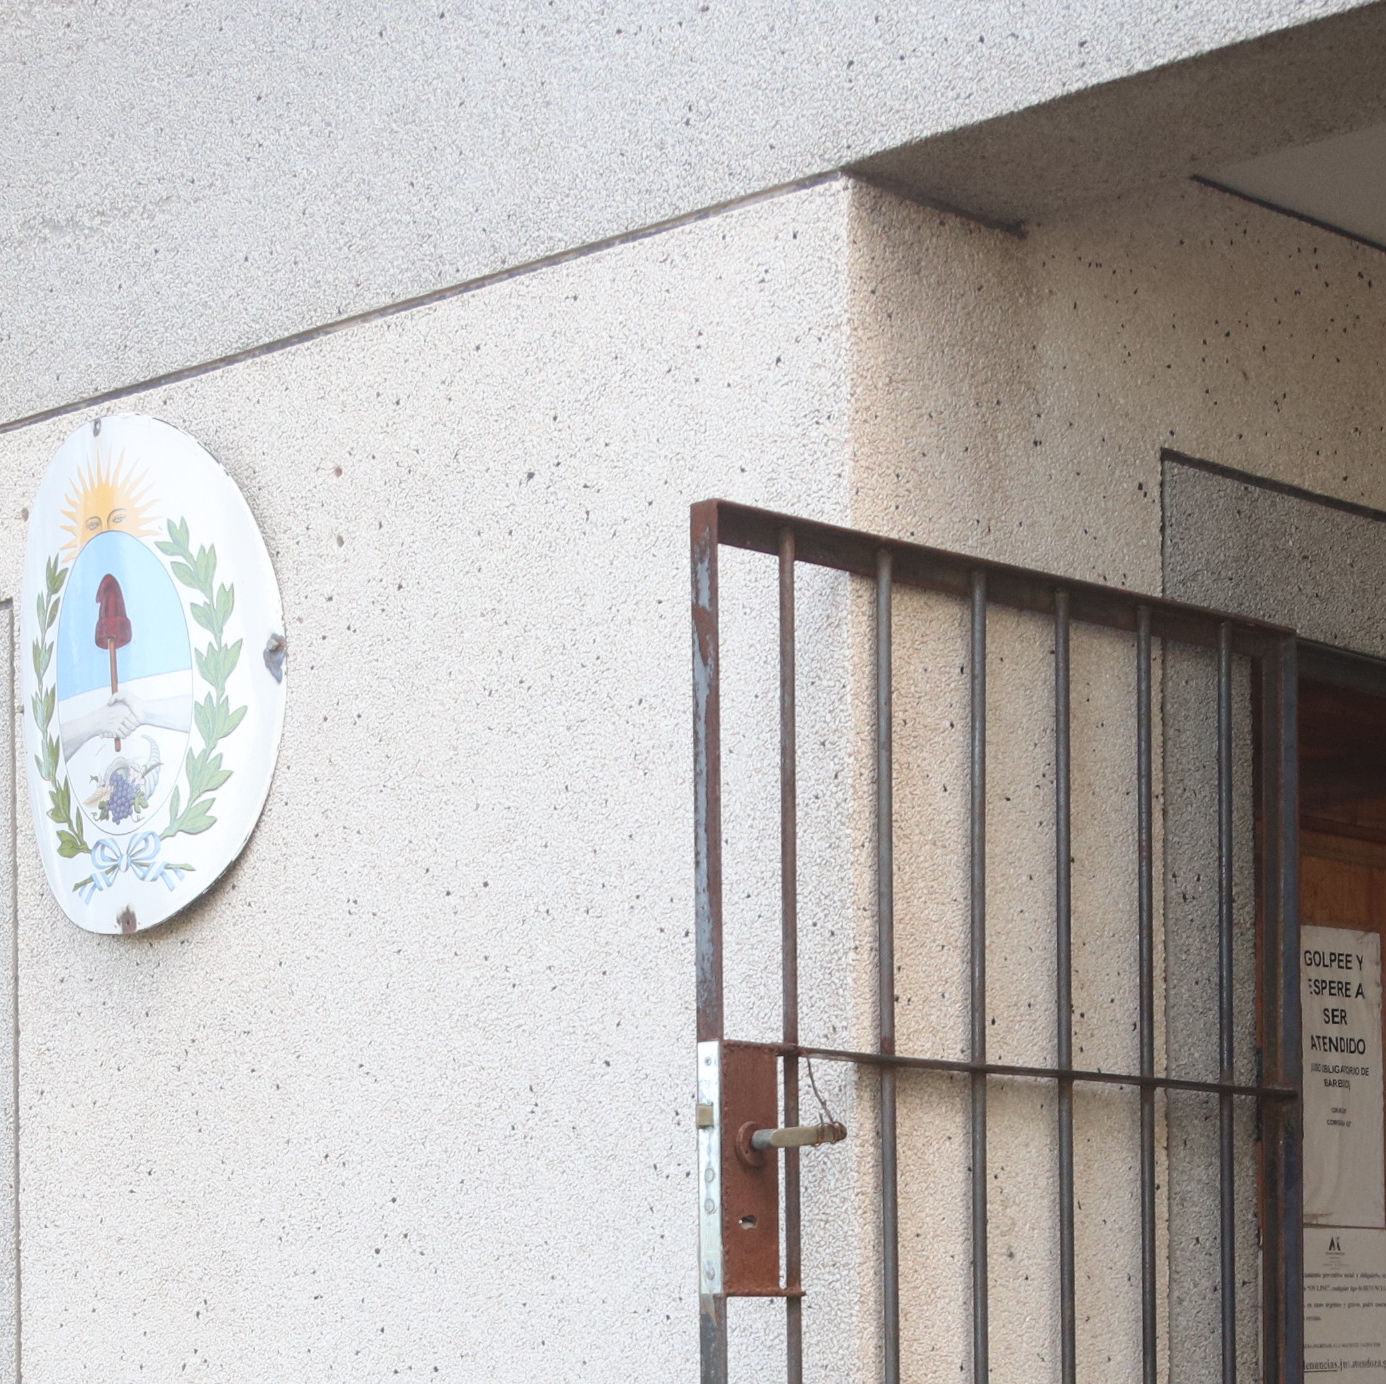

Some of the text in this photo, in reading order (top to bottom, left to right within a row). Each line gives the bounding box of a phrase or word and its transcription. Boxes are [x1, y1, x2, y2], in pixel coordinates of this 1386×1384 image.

[1304, 950, 1363, 971] GOLPEE Y
[1355, 983, 1365, 999] A
[1323, 1008, 1348, 1025] SER
[1310, 1034, 1366, 1055] ATENDIDO
[1361, 1067, 1370, 1076] DE
